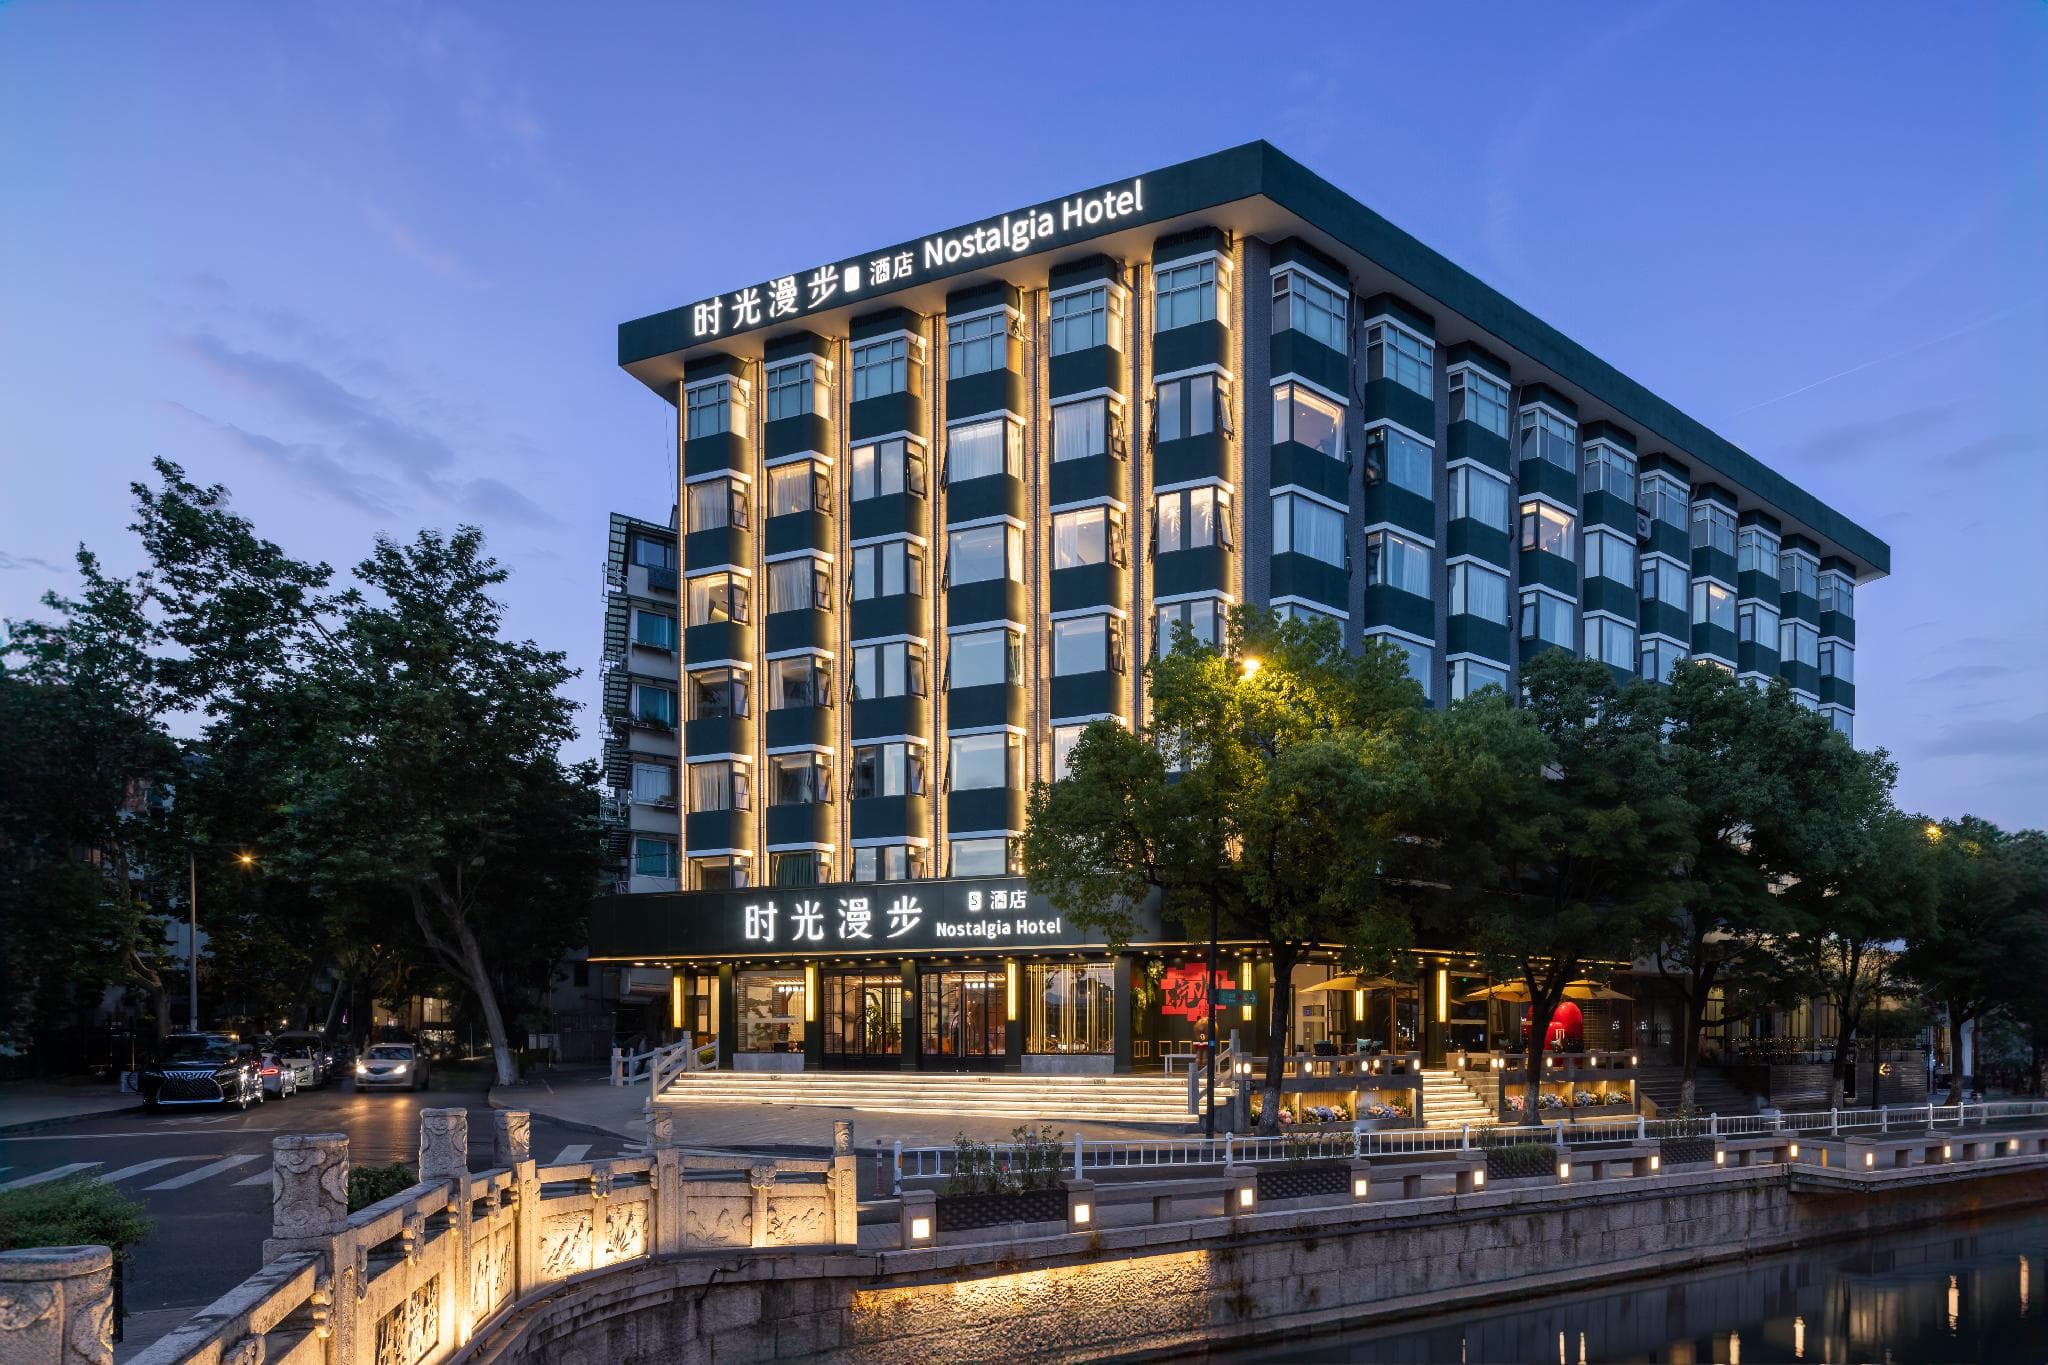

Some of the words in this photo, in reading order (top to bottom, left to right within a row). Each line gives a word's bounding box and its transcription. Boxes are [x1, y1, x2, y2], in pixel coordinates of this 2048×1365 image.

[924, 209, 1055, 269] Nostalgia
[1062, 178, 1144, 232] Hotel
[693, 265, 840, 337] 时光漫步
[869, 251, 914, 286] 酒店
[744, 895, 923, 943] 时光漫步
[989, 889, 1028, 911] 酒店
[936, 919, 1012, 941] Nostalgia
[1016, 916, 1062, 936] Hotel
